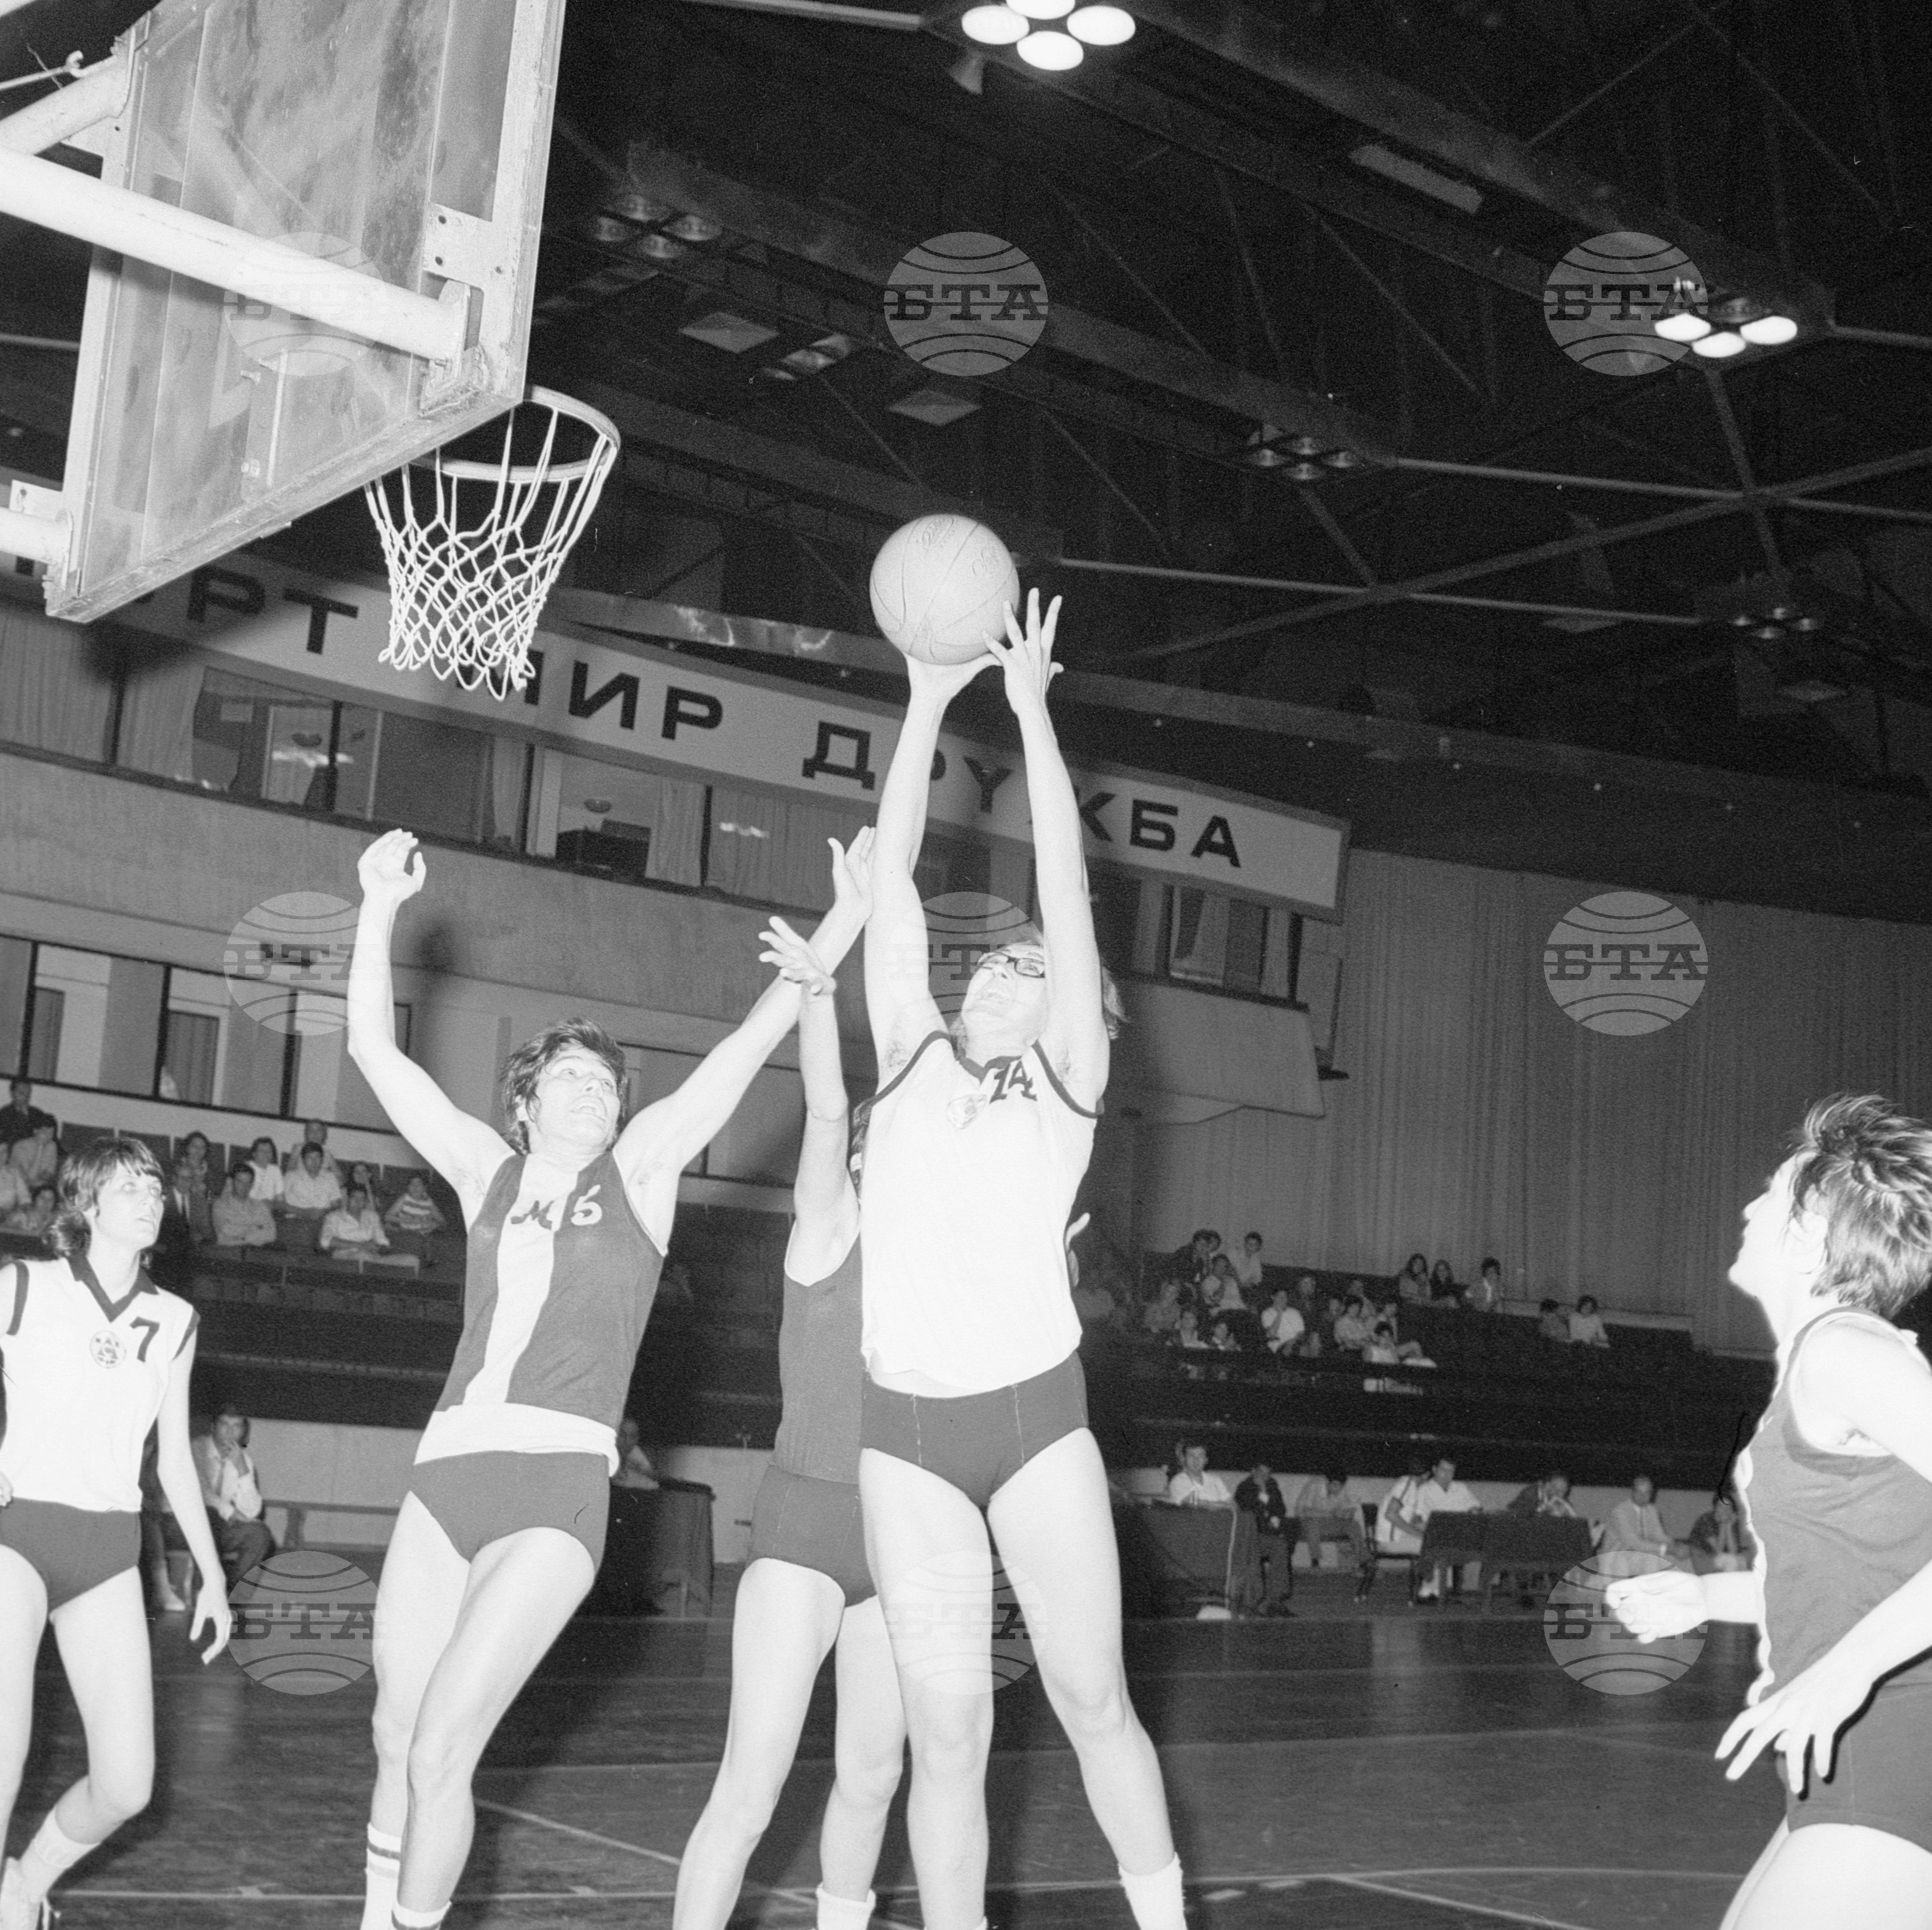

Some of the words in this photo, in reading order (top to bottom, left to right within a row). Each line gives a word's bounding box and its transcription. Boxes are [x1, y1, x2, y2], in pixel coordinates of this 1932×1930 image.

[133, 564, 359, 655] РТ
[802, 720, 1241, 868] ДУБА
[129, 1316, 160, 1363] 7
